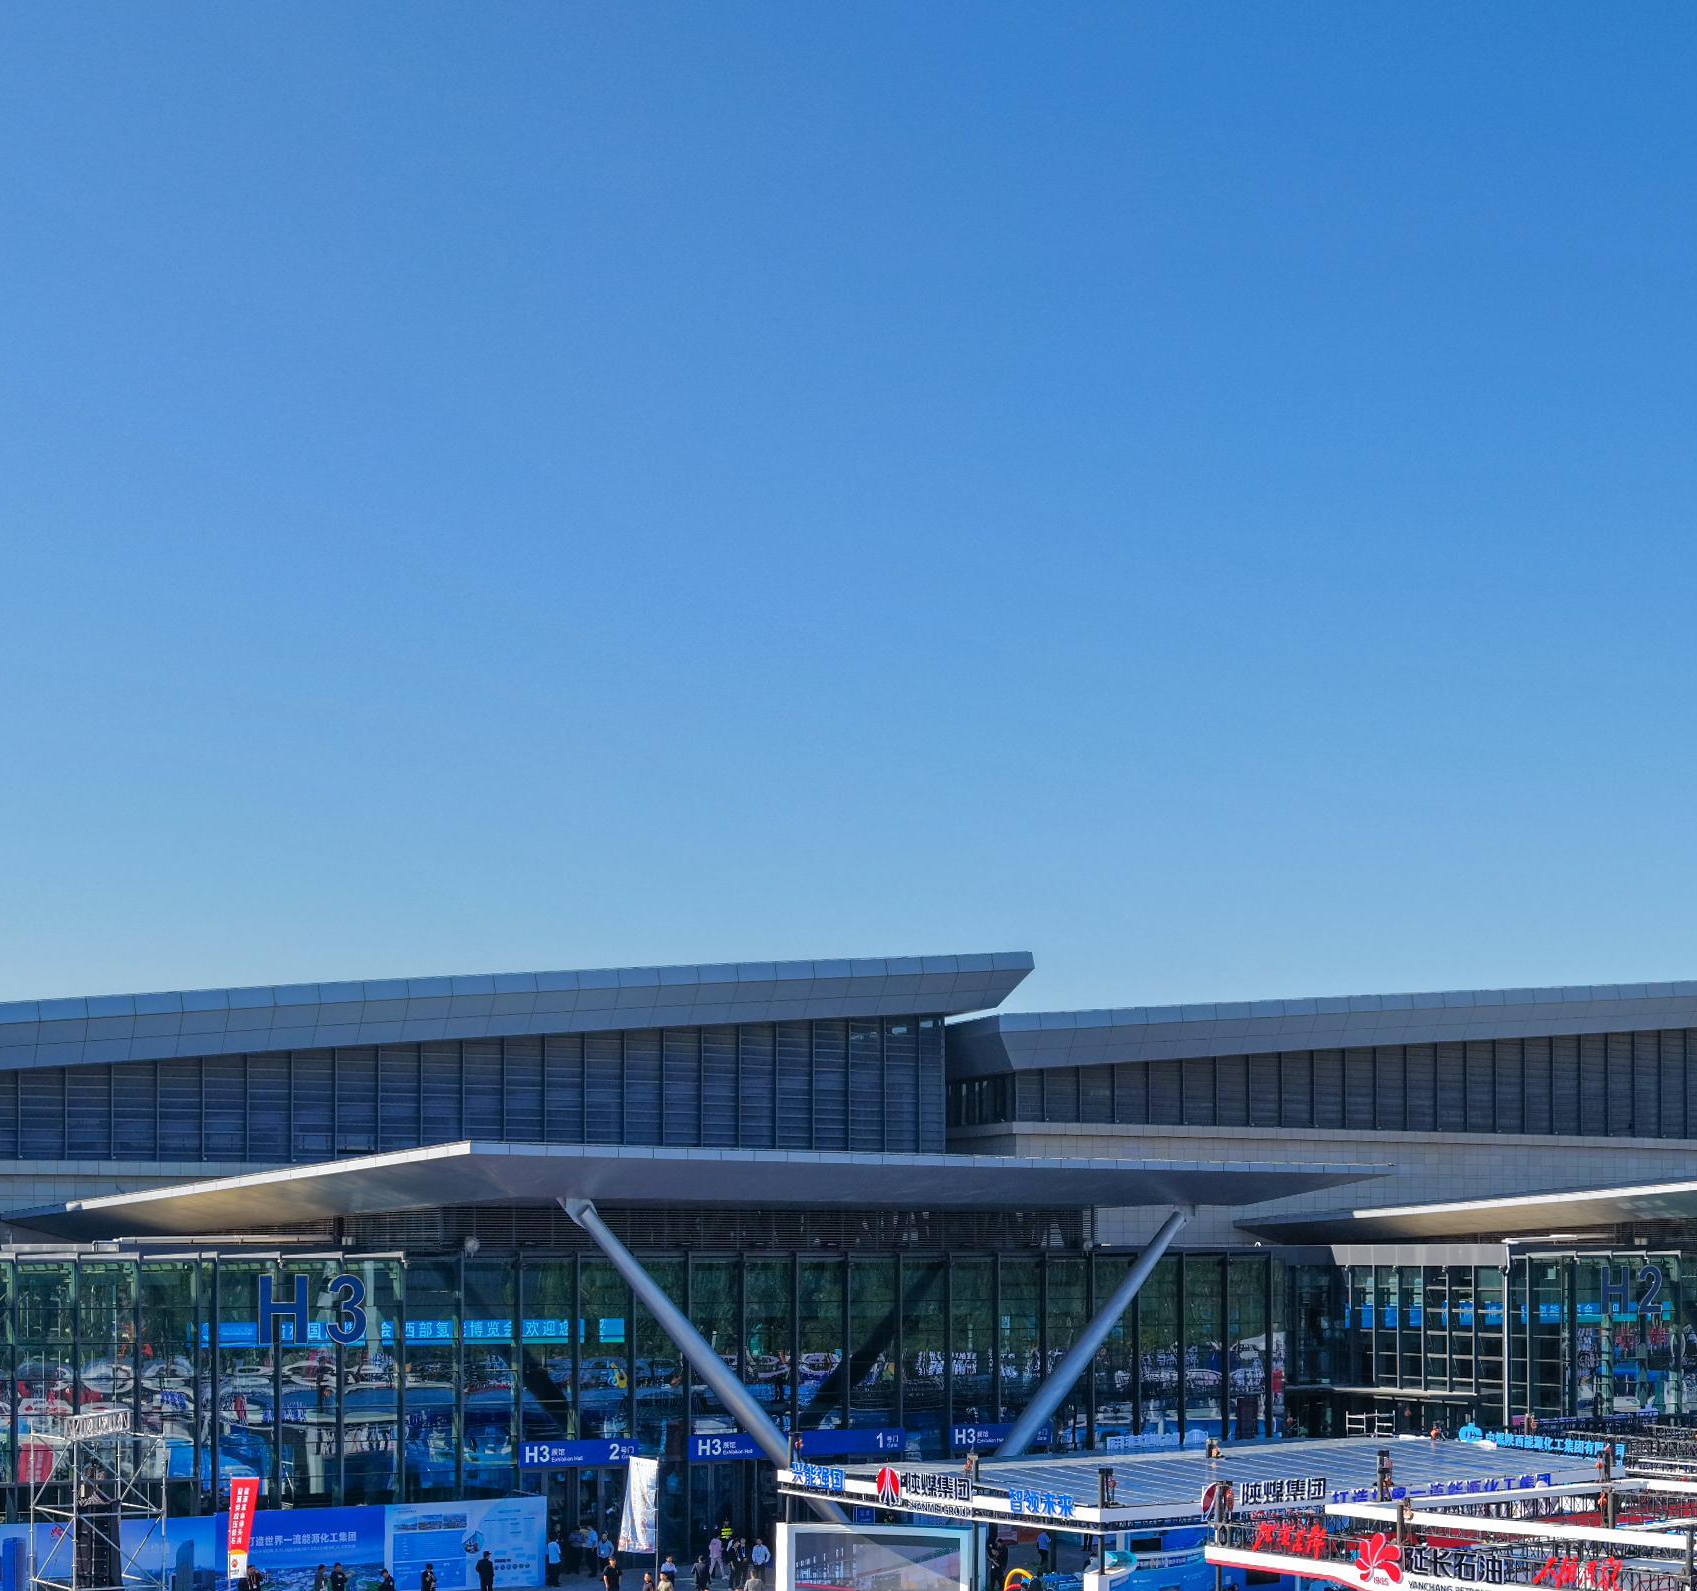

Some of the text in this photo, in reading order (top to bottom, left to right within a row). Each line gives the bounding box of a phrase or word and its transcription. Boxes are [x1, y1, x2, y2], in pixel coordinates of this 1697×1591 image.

[1601, 1264, 1664, 1316] H2
[257, 1273, 368, 1345] H3
[697, 1439, 722, 1456] H3
[876, 1432, 884, 1448] 1
[954, 1429, 976, 1446] H3
[524, 1445, 550, 1463] H3
[609, 1443, 620, 1460] 2
[905, 1471, 972, 1502] 陕煤集团
[1239, 1477, 1327, 1506] 陕煤集团
[1008, 1488, 1076, 1518] 智领未来
[1410, 1546, 1506, 1585] 延长石油
